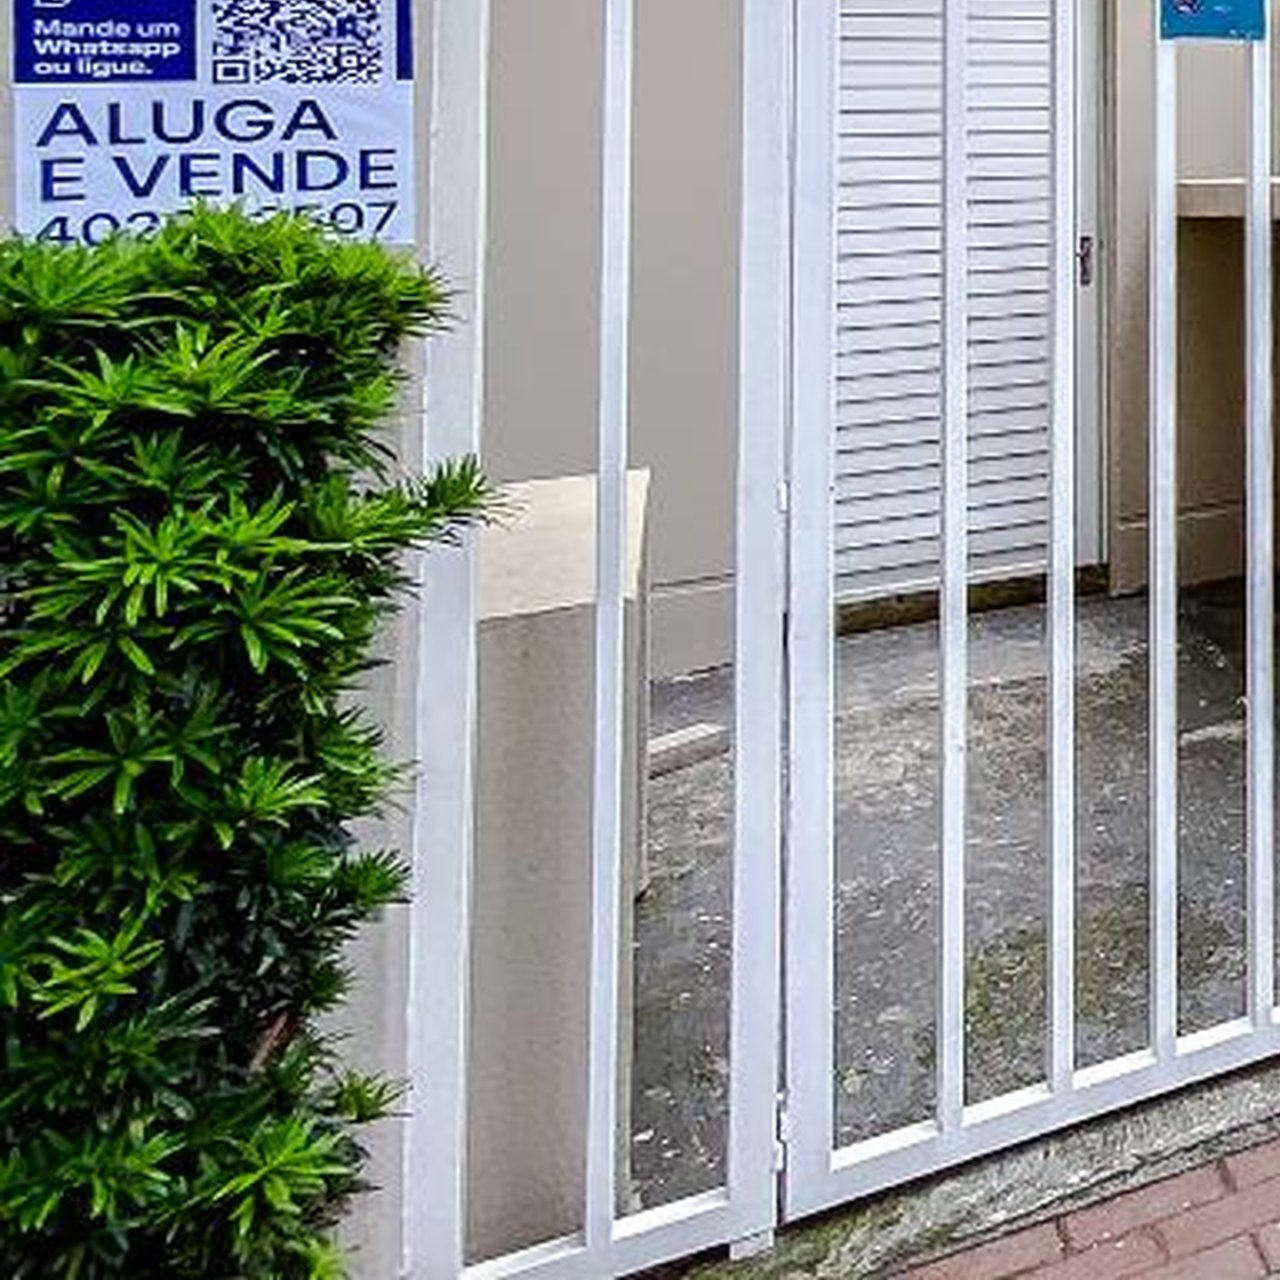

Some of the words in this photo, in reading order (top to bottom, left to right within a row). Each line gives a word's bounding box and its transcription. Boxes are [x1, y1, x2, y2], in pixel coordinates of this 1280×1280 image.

[34, 19, 131, 37] Mande
[137, 22, 181, 37] um
[33, 38, 181, 58] Whatsapp
[34, 62, 71, 75] ou
[78, 58, 153, 78] ligue.
[36, 100, 338, 147] ALUGA
[40, 157, 86, 202] E
[112, 149, 398, 198] VENDE
